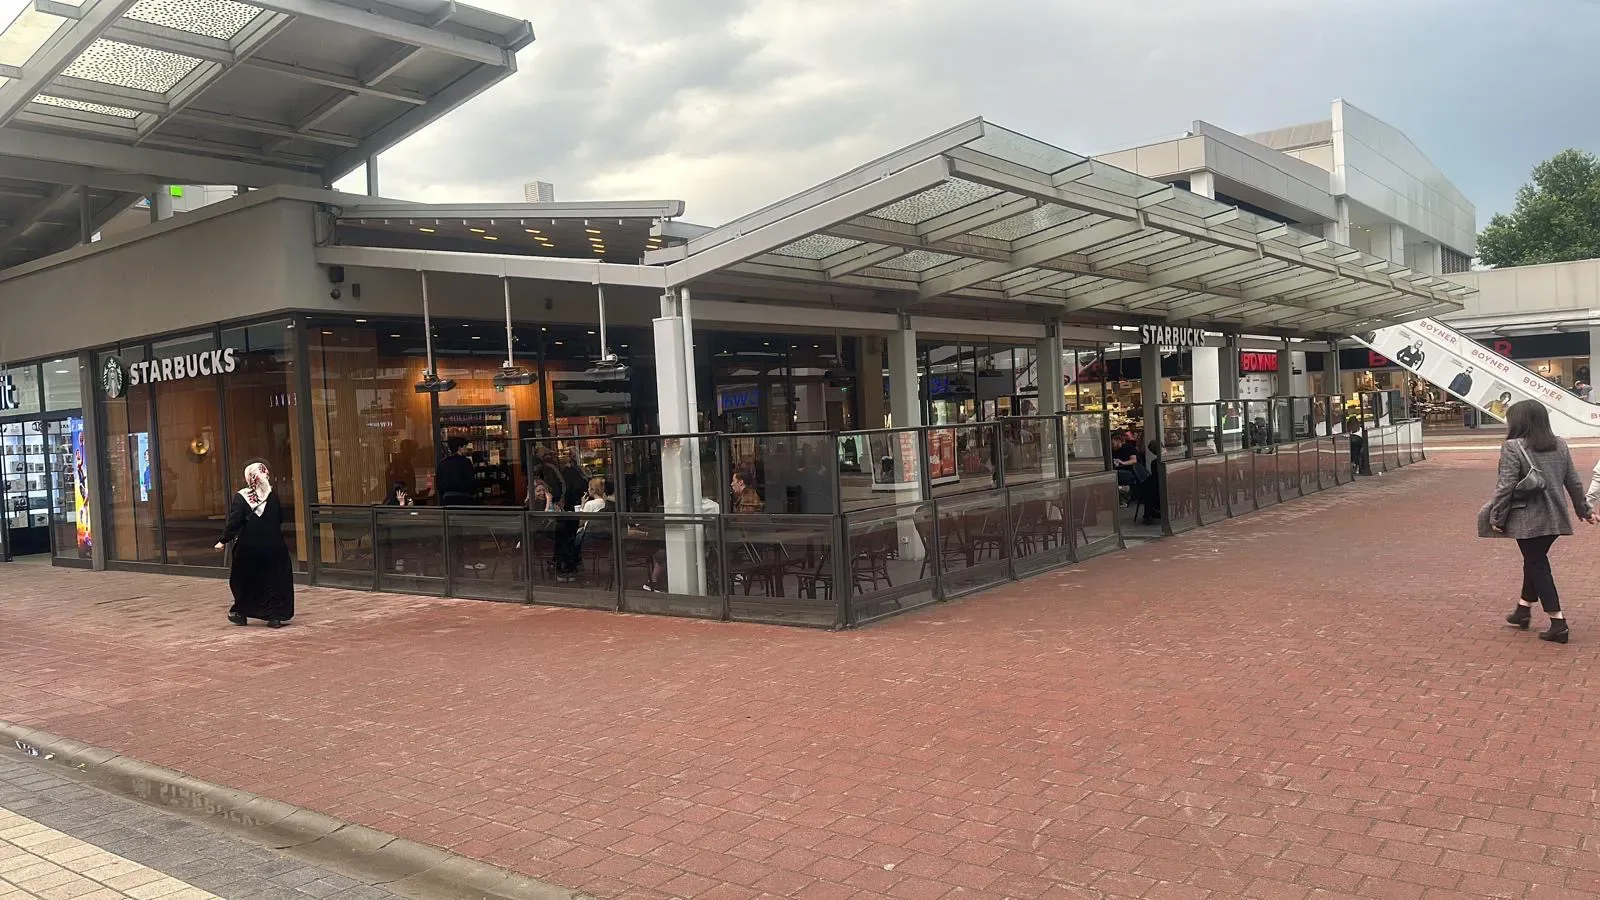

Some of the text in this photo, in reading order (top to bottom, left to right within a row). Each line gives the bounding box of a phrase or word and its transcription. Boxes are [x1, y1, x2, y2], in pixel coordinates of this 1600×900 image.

[1142, 324, 1205, 347] STARBUCKS
[1420, 321, 1457, 345] BOYNER
[130, 347, 236, 386] STARBUCKS
[1471, 349, 1510, 373] BOYNER
[1522, 376, 1563, 402] BOYNER
